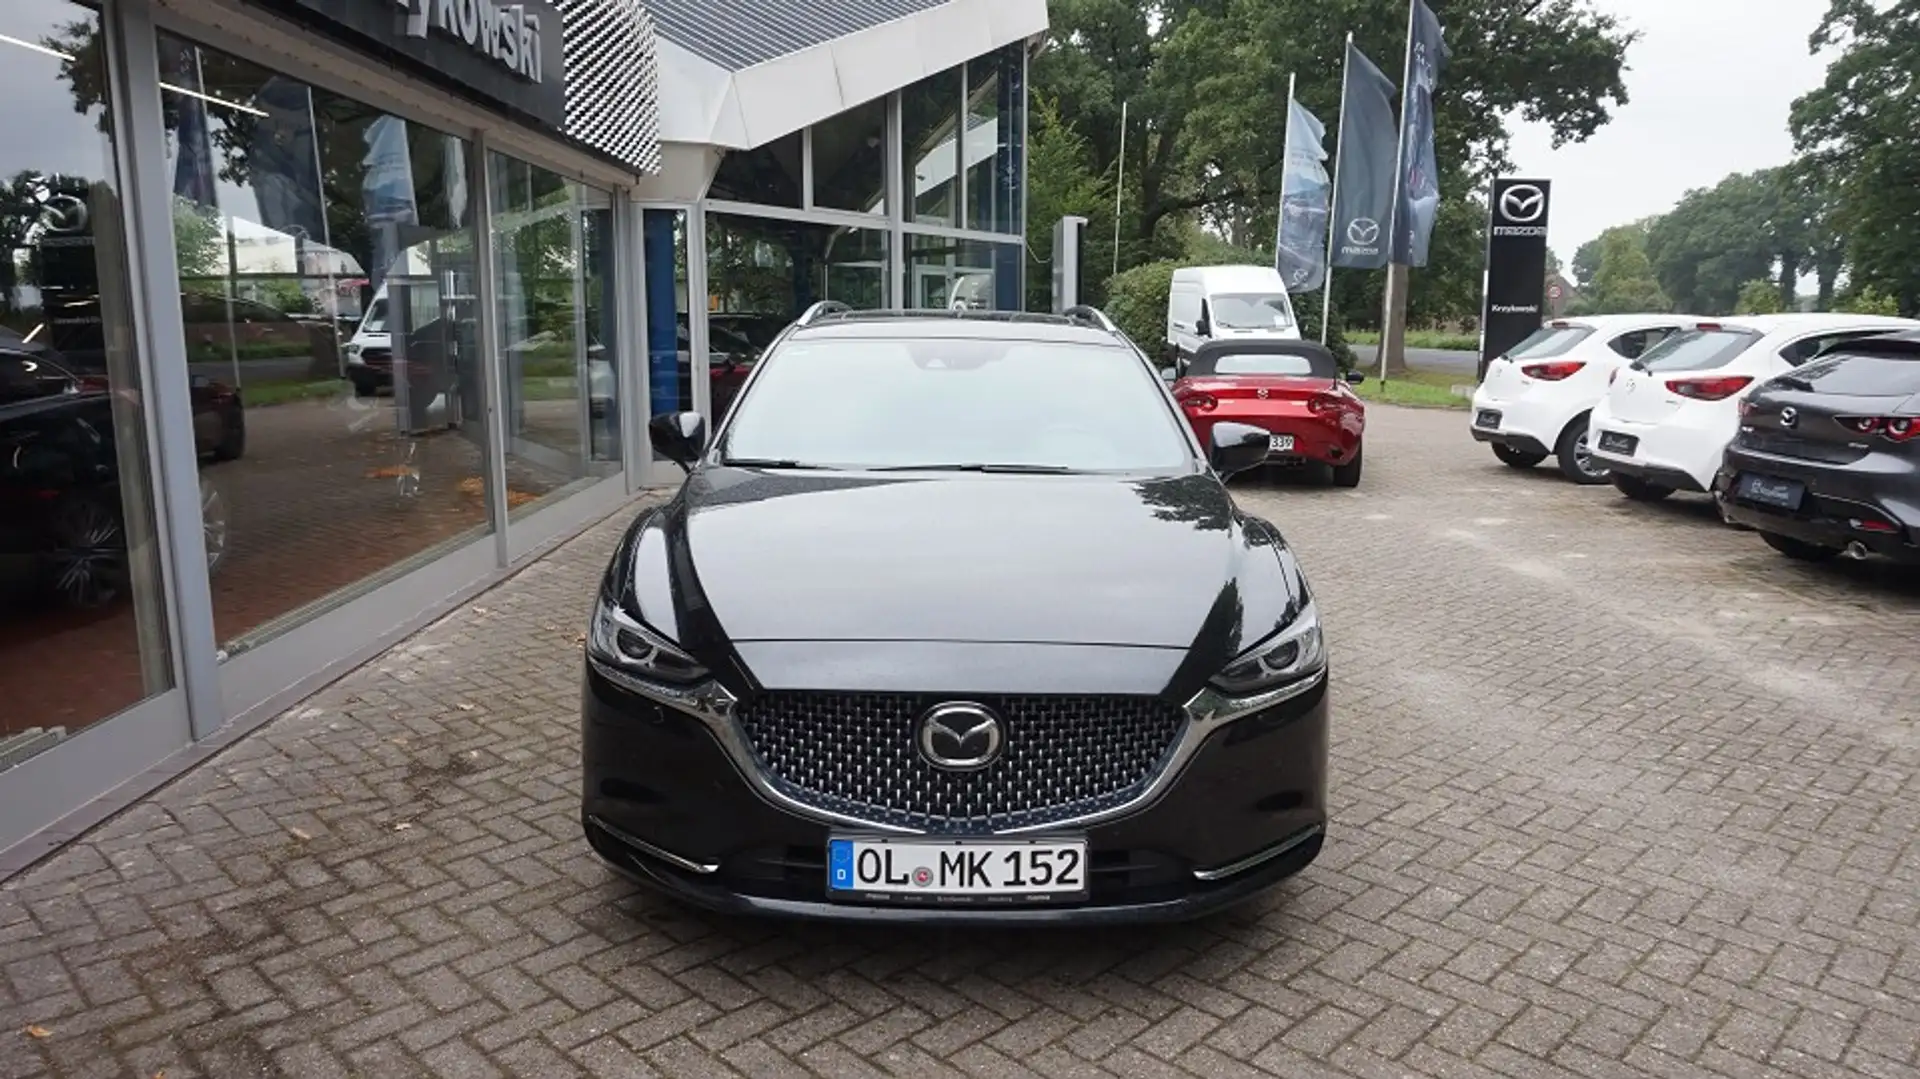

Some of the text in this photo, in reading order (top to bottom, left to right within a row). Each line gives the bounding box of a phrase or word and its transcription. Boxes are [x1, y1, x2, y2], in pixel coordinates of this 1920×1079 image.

[836, 869, 847, 880] D
[857, 848, 1079, 887] OL MK 152
